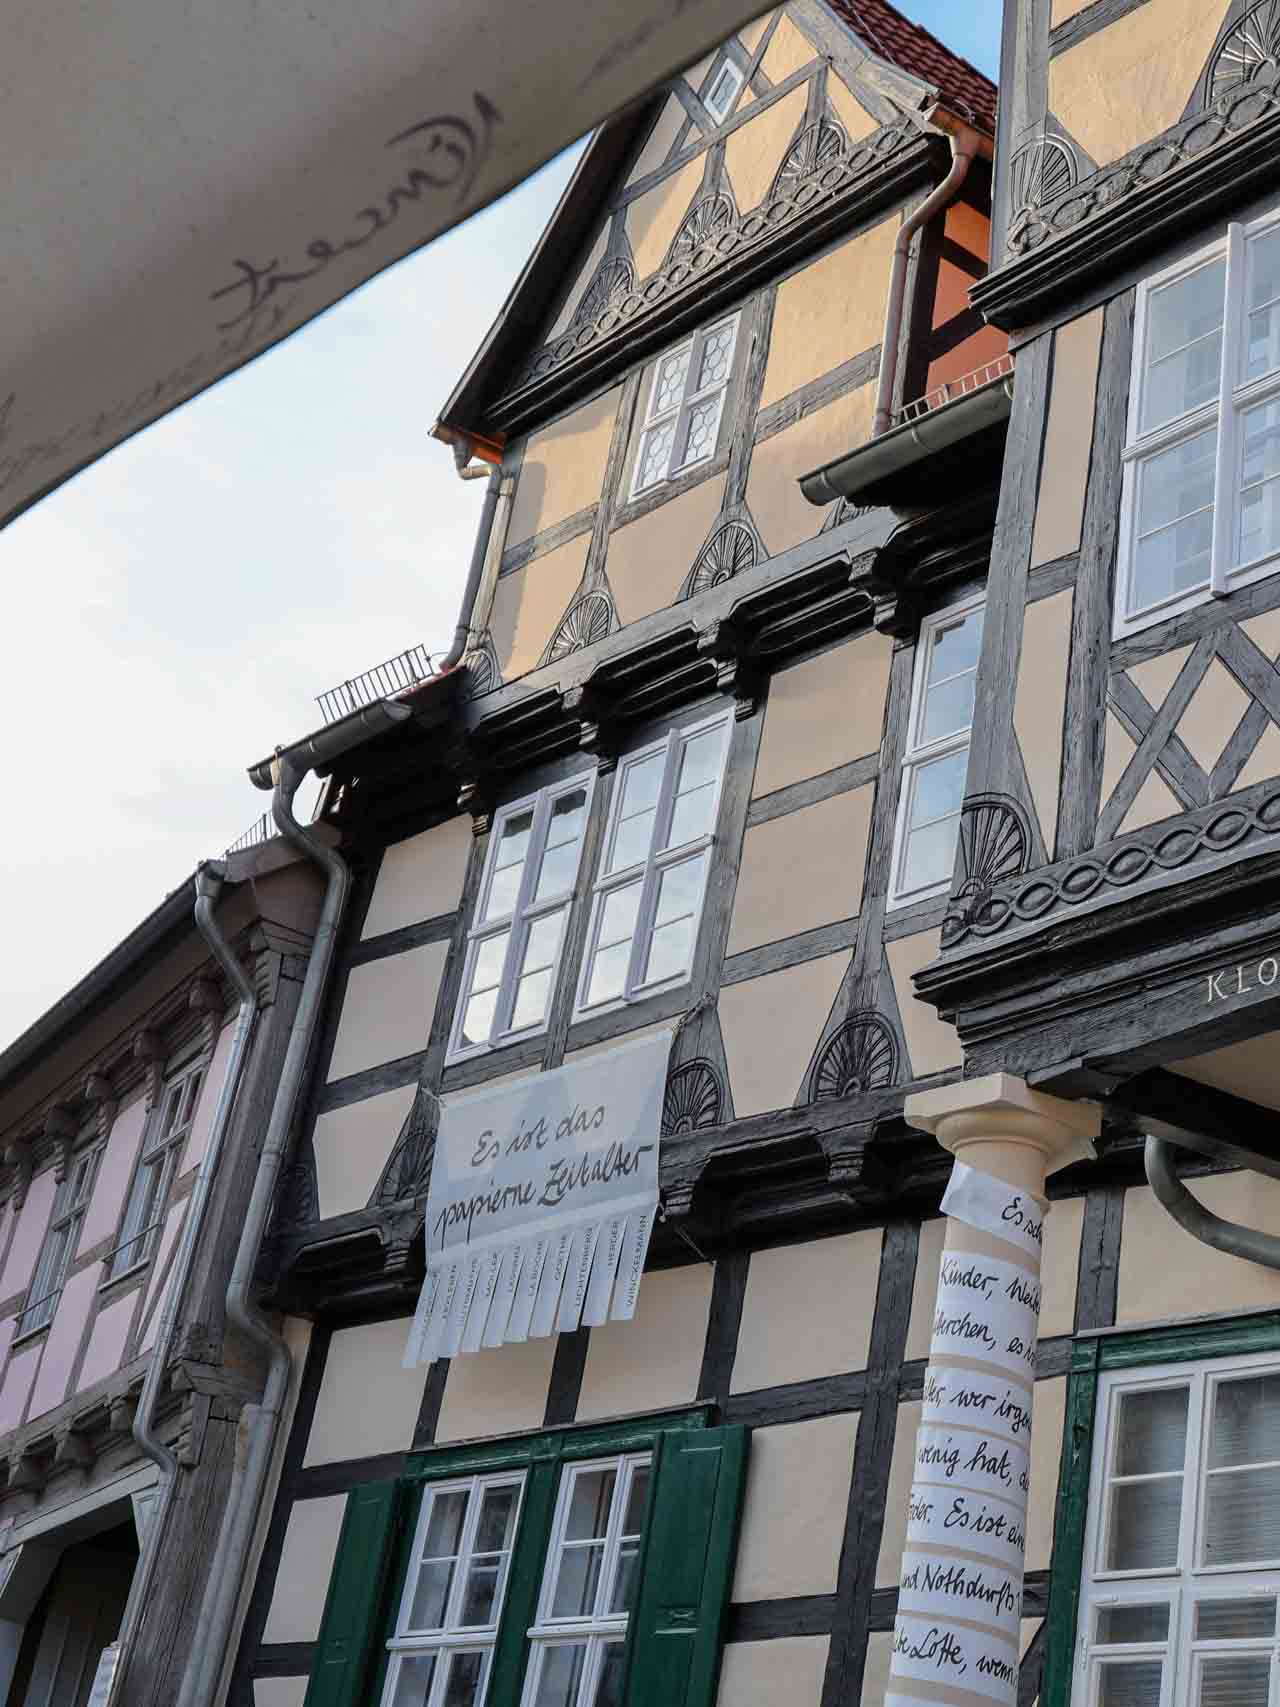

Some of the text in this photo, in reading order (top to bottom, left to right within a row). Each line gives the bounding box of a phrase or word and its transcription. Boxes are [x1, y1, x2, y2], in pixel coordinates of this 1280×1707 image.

[471, 1103, 605, 1168] Es ist das
[433, 1178, 537, 1254] papierne
[1001, 1196, 1024, 1227] Es
[1006, 1336, 1024, 1356] es
[950, 1389, 997, 1409] wer
[963, 1441, 1012, 1487] hat,
[943, 1497, 970, 1528] Es
[969, 1505, 1008, 1537] ist
